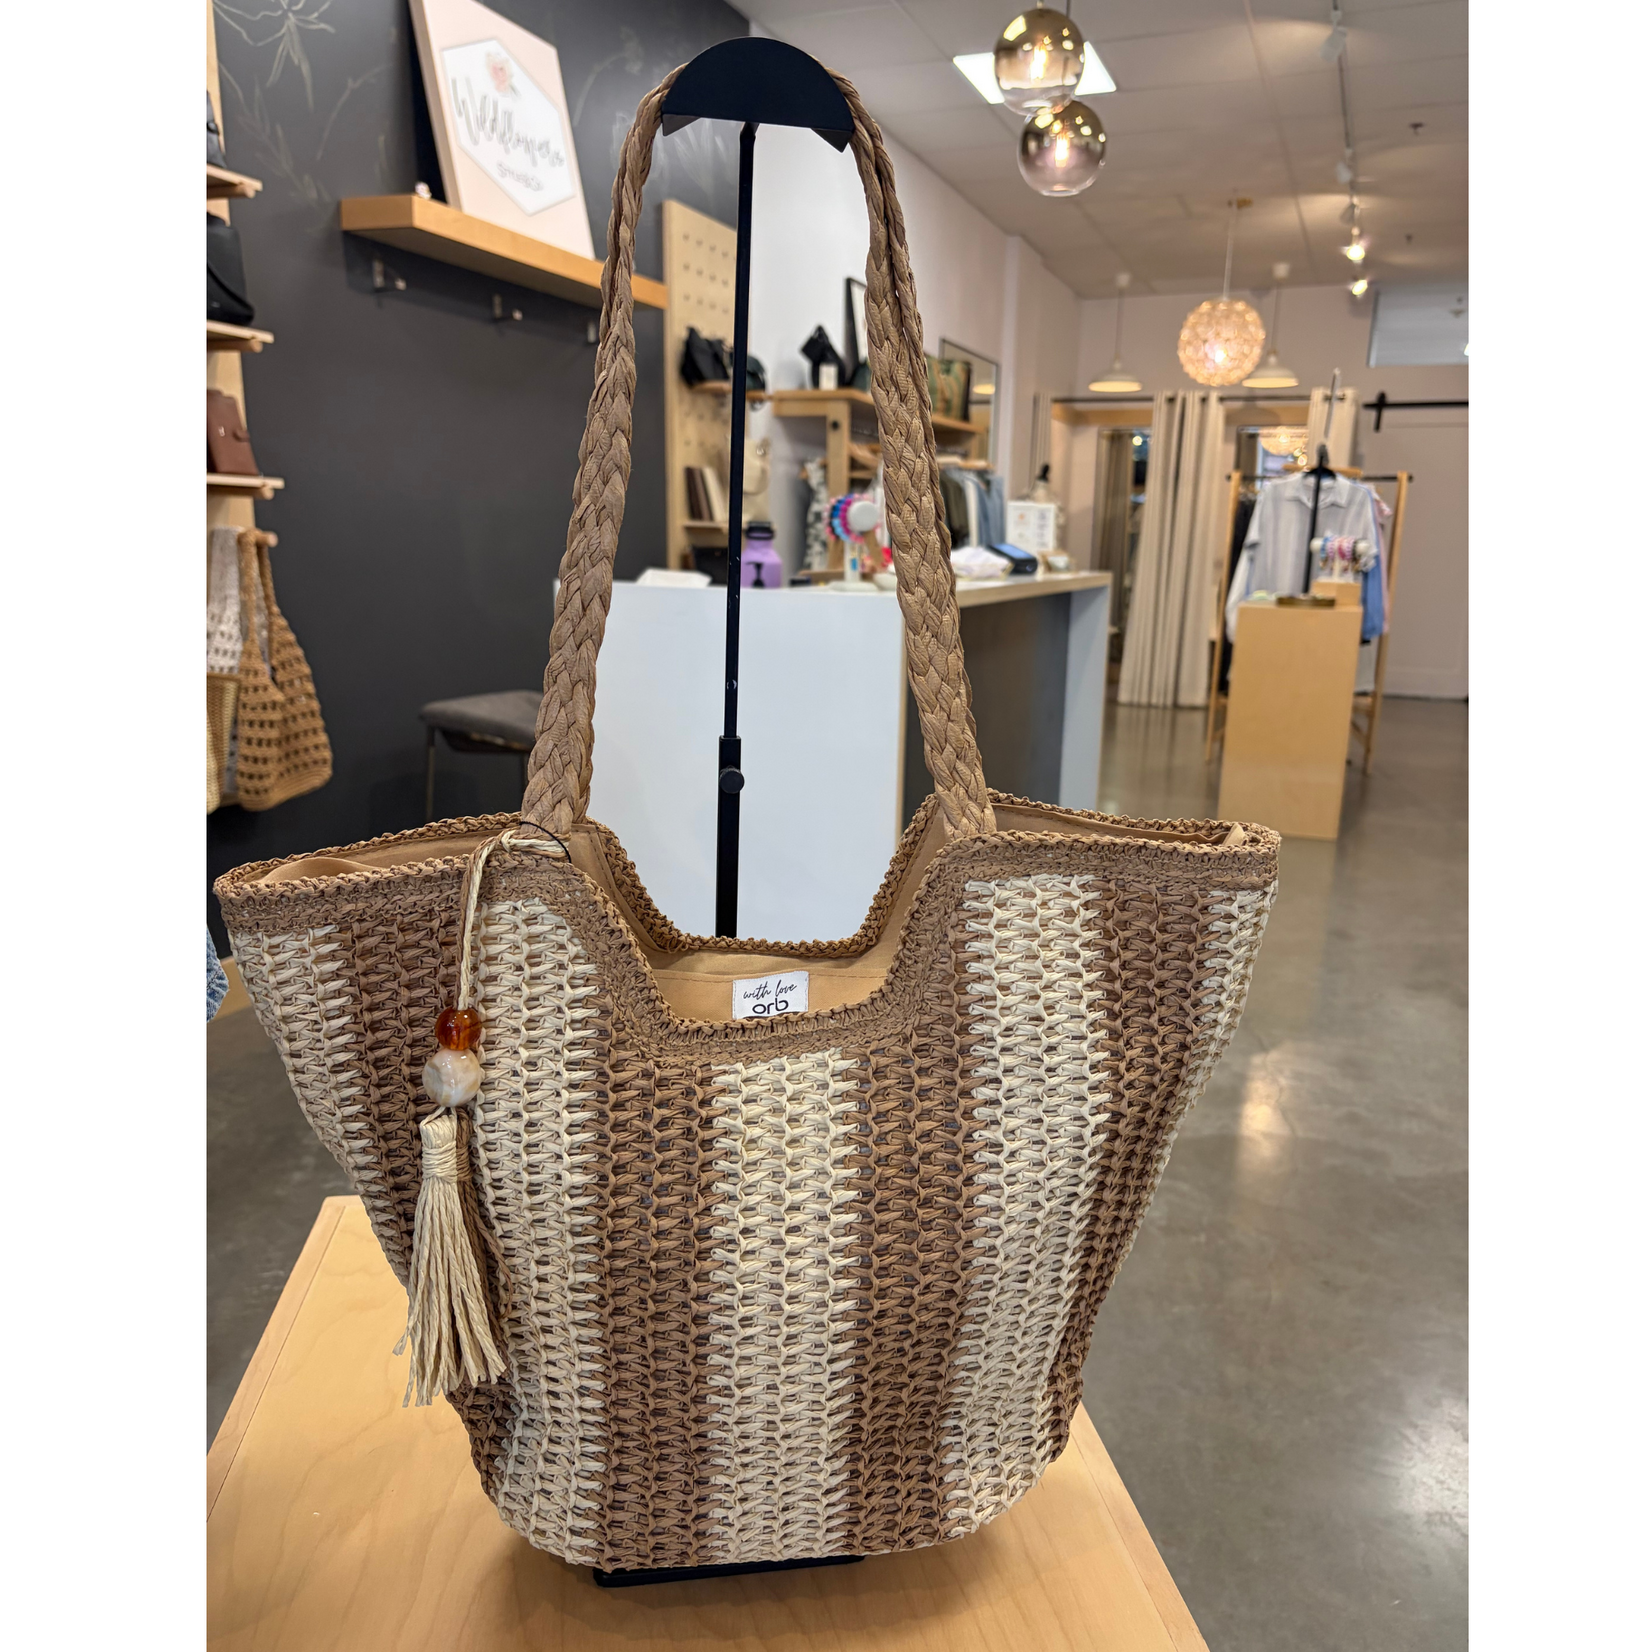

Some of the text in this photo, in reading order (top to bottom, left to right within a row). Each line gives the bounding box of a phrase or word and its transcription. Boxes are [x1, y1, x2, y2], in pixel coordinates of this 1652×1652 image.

[743, 979, 798, 1000] with love
[752, 997, 789, 1015] orb
